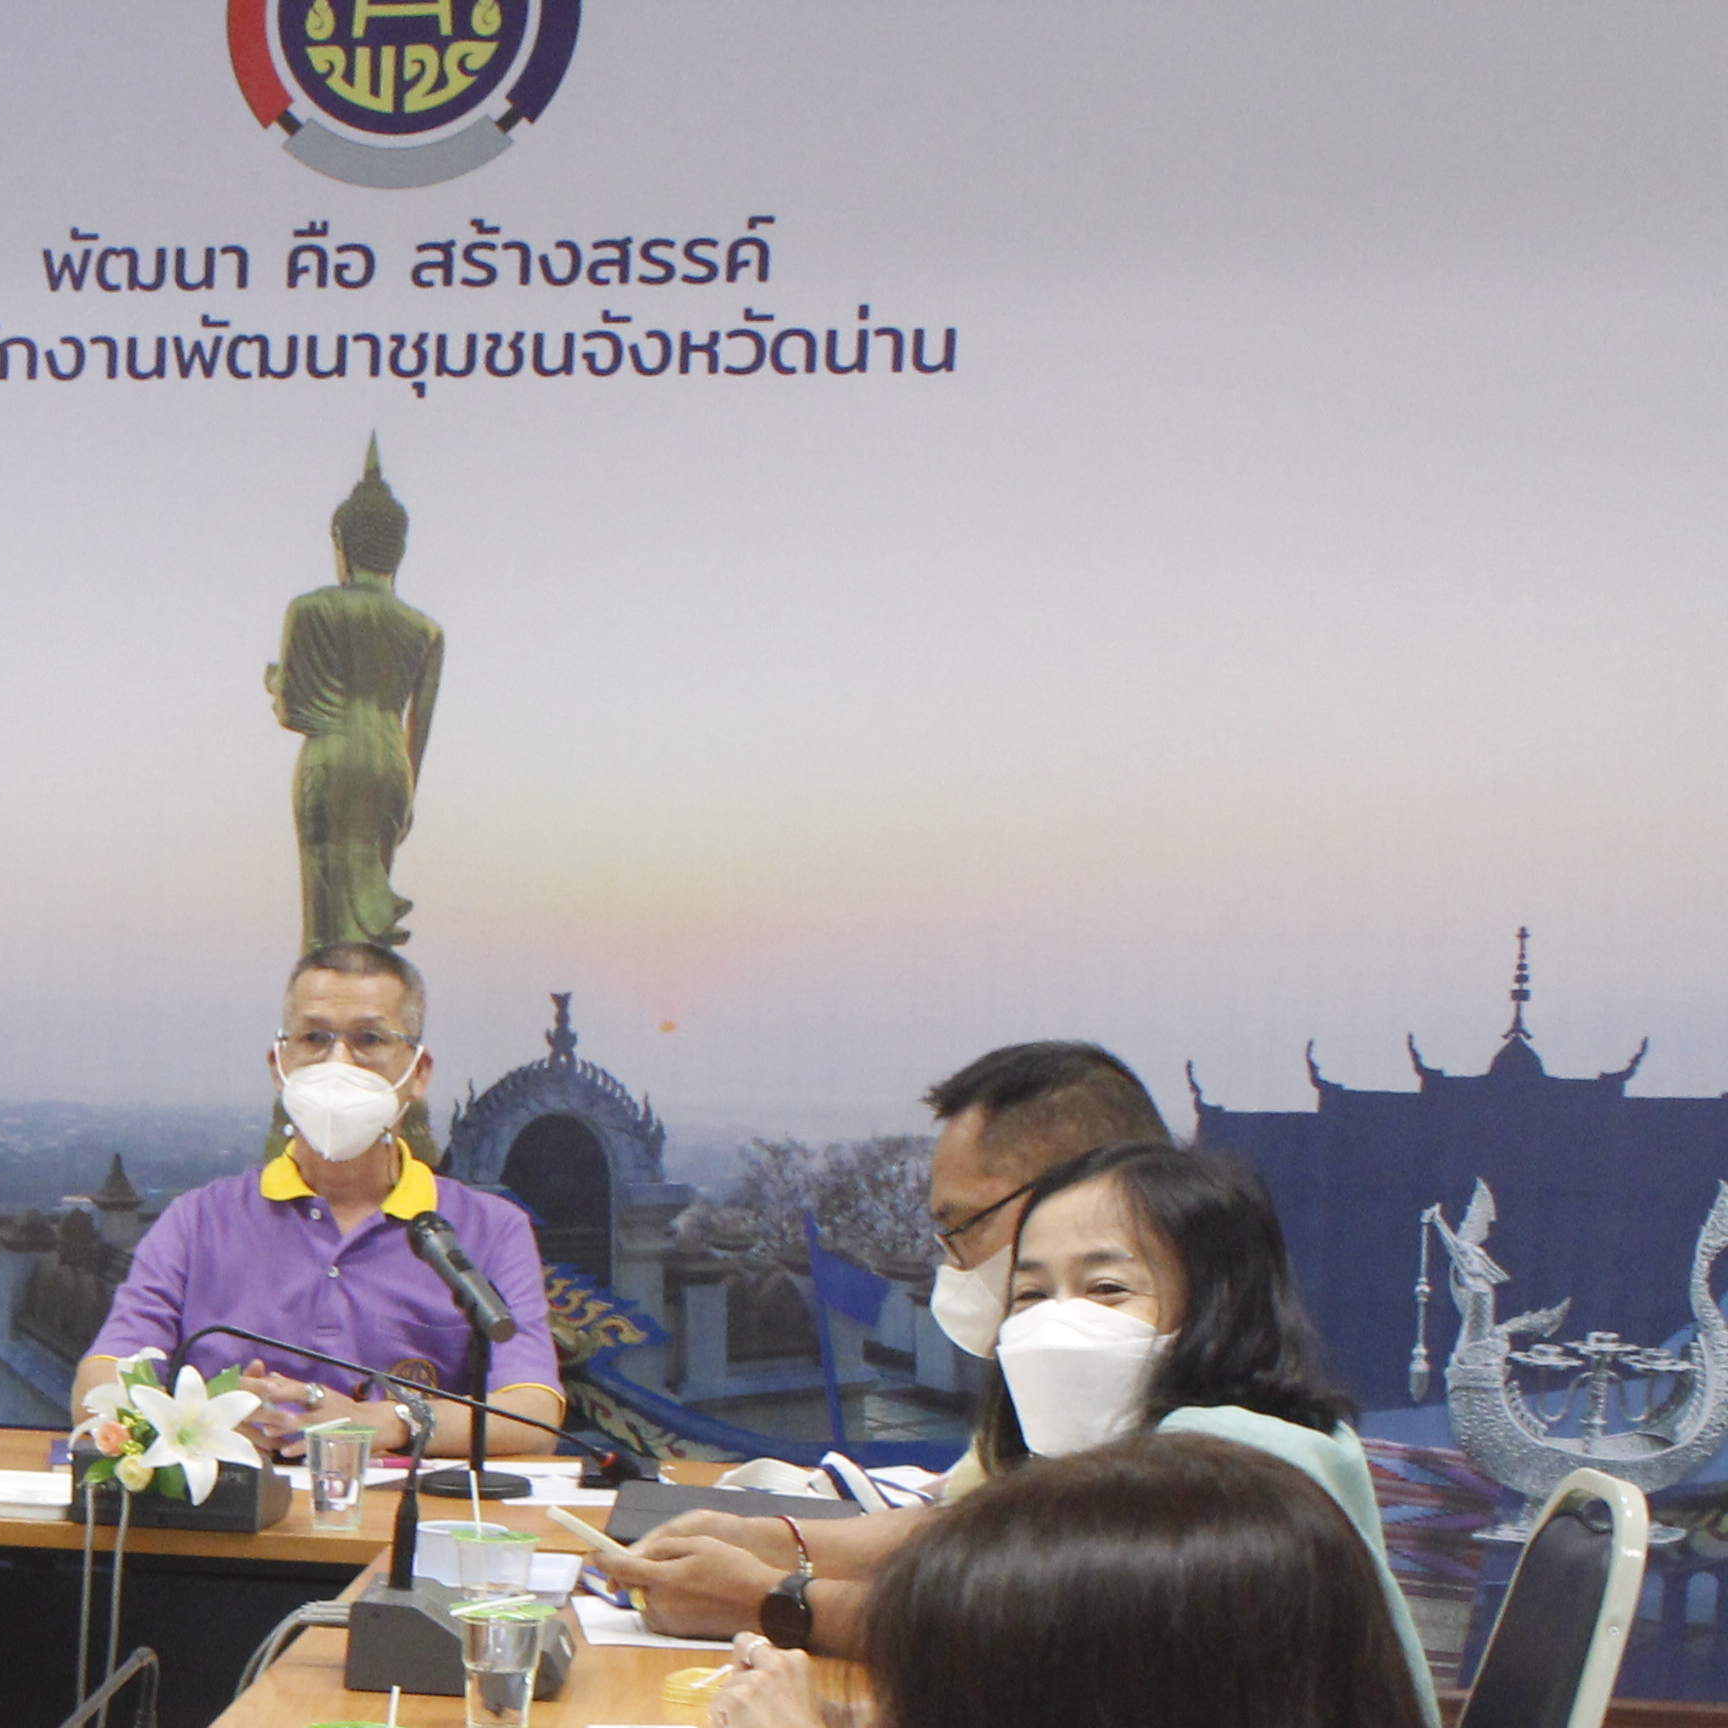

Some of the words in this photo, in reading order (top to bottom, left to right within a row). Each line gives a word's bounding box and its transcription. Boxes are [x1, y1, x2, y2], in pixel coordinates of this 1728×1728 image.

[41, 226, 250, 294] พัฒนา
[285, 219, 377, 291] คือ
[410, 214, 777, 290] สร้างสรรค์
